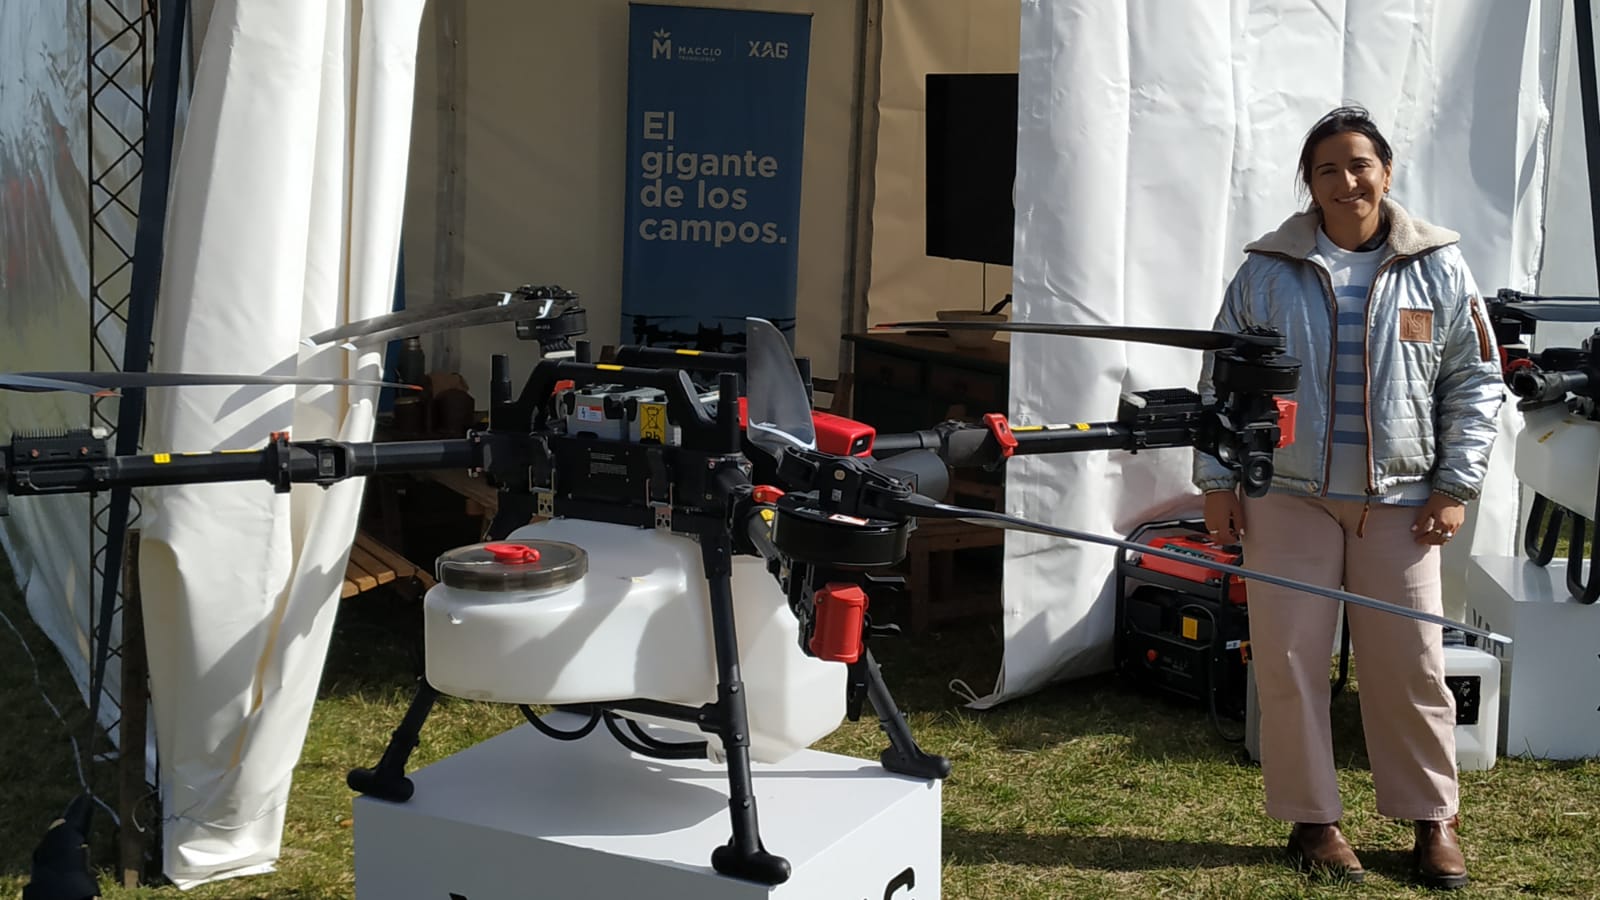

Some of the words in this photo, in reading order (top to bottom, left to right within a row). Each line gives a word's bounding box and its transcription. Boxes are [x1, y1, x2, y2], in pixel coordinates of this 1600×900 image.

[678, 46, 722, 56] MACCIO
[748, 40, 789, 59] XAG
[643, 111, 675, 140] El
[641, 145, 778, 180] gigante
[640, 178, 685, 208] de
[697, 179, 748, 210] los
[639, 217, 788, 248] campos.
